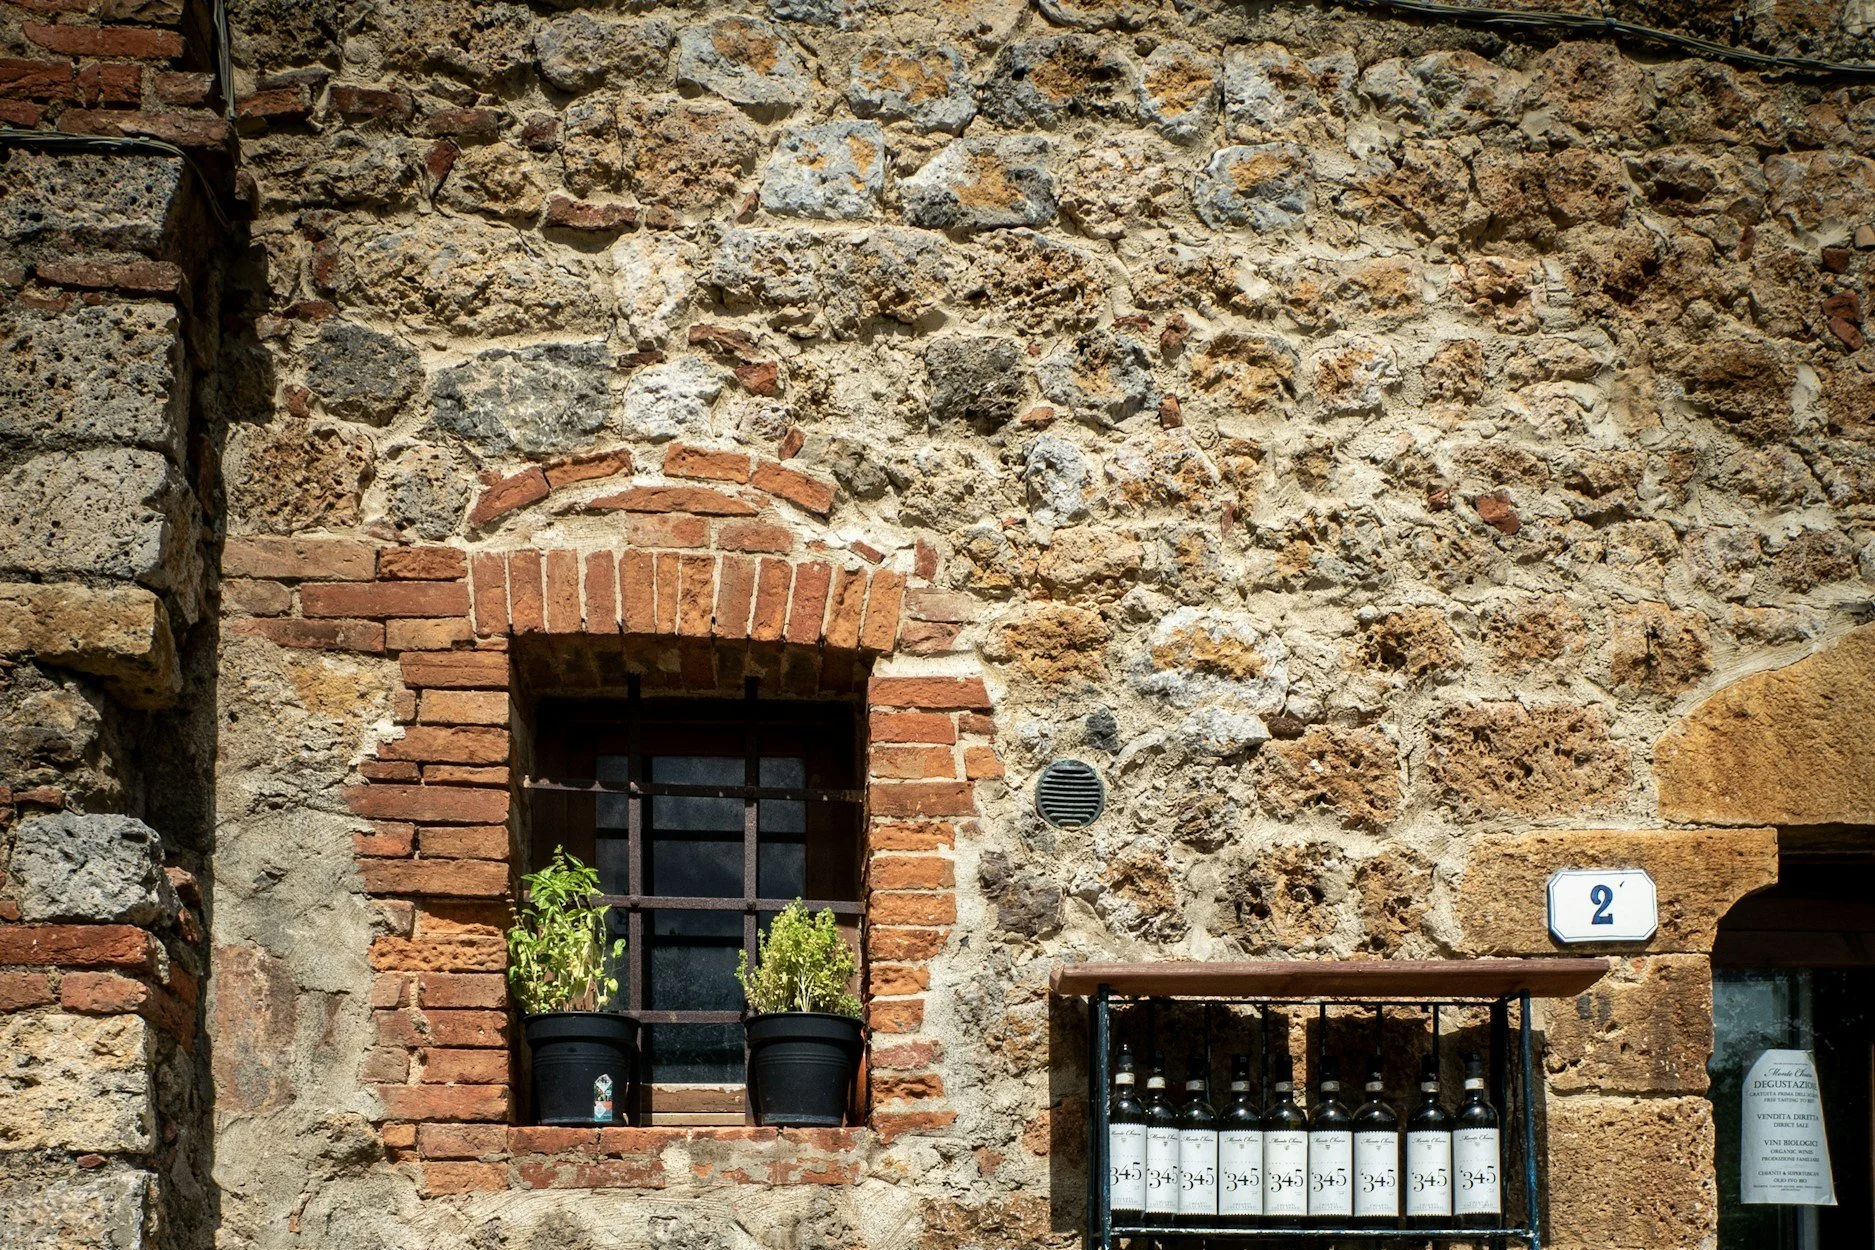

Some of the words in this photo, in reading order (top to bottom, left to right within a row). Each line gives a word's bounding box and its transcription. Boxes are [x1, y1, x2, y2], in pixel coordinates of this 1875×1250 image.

[1590, 884, 1614, 925] 2
[1180, 1166, 1215, 1191] '345
[1225, 1167, 1260, 1192] '345
[1268, 1168, 1304, 1193] '345
[1311, 1168, 1347, 1192] '345
[1361, 1169, 1396, 1193] '345
[1411, 1168, 1447, 1192] '345
[1460, 1165, 1496, 1191] '345
